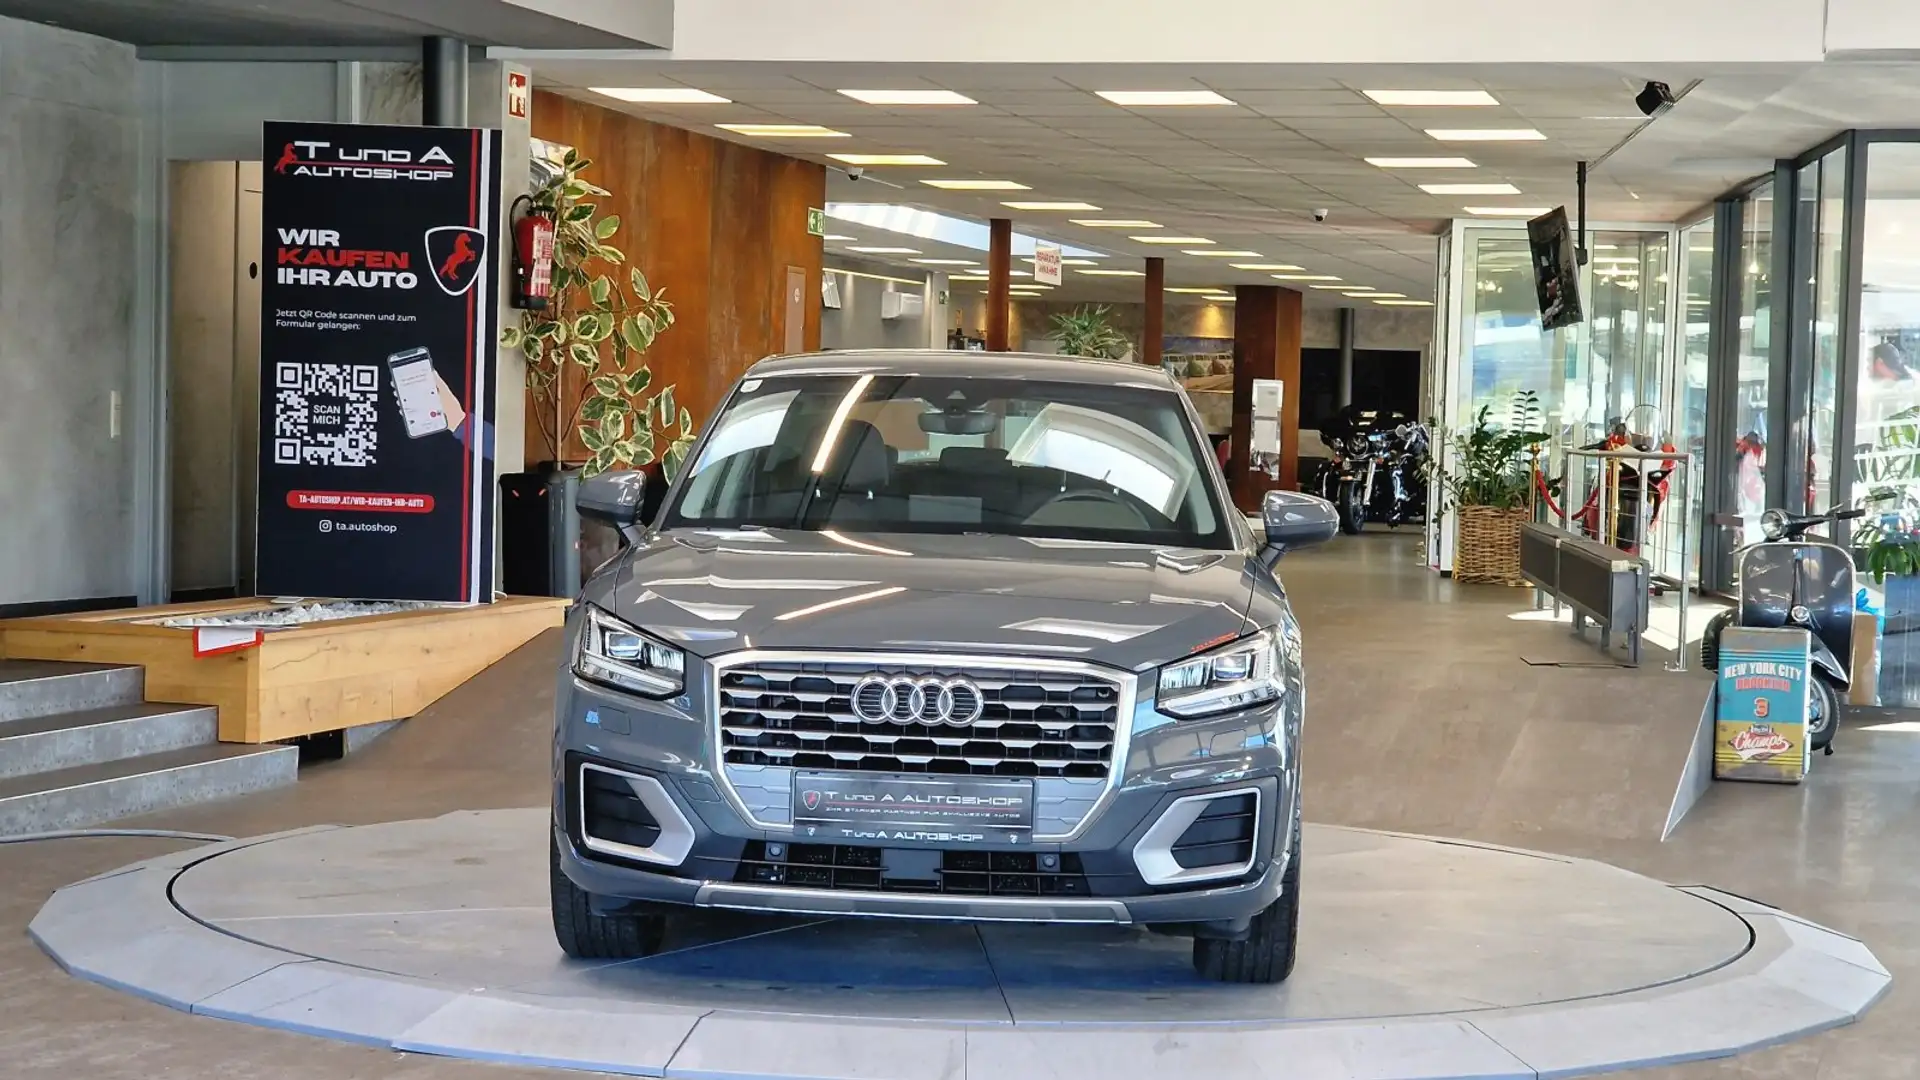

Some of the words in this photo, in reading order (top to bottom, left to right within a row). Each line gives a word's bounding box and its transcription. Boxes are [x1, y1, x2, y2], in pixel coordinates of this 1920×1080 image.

[294, 140, 331, 159] T
[418, 145, 454, 165] A
[293, 165, 454, 181] AUTOSHOP
[277, 228, 340, 247] WIR
[277, 248, 409, 269] KAUFEN
[277, 268, 330, 286] IHR
[333, 270, 418, 289] AUTO
[276, 308, 298, 318] Jetzt
[298, 310, 313, 319] QR
[314, 310, 338, 319] Code
[338, 312, 376, 321] scannen
[377, 313, 395, 321] und
[397, 314, 417, 322] zum
[276, 319, 316, 329] Formular
[317, 321, 361, 332] gelangen:
[313, 404, 341, 414] SCAN
[313, 415, 341, 425] MICH
[335, 522, 398, 534] ta.autoshop
[1724, 662, 1747, 679] NEW
[1749, 661, 1777, 676] YORK
[1778, 663, 1803, 681] CITY
[1754, 697, 1769, 717] 3
[824, 791, 839, 799] T
[880, 793, 895, 802] A
[901, 794, 1023, 806] AUTOSHOP
[893, 831, 984, 842] AUTOSHOP
